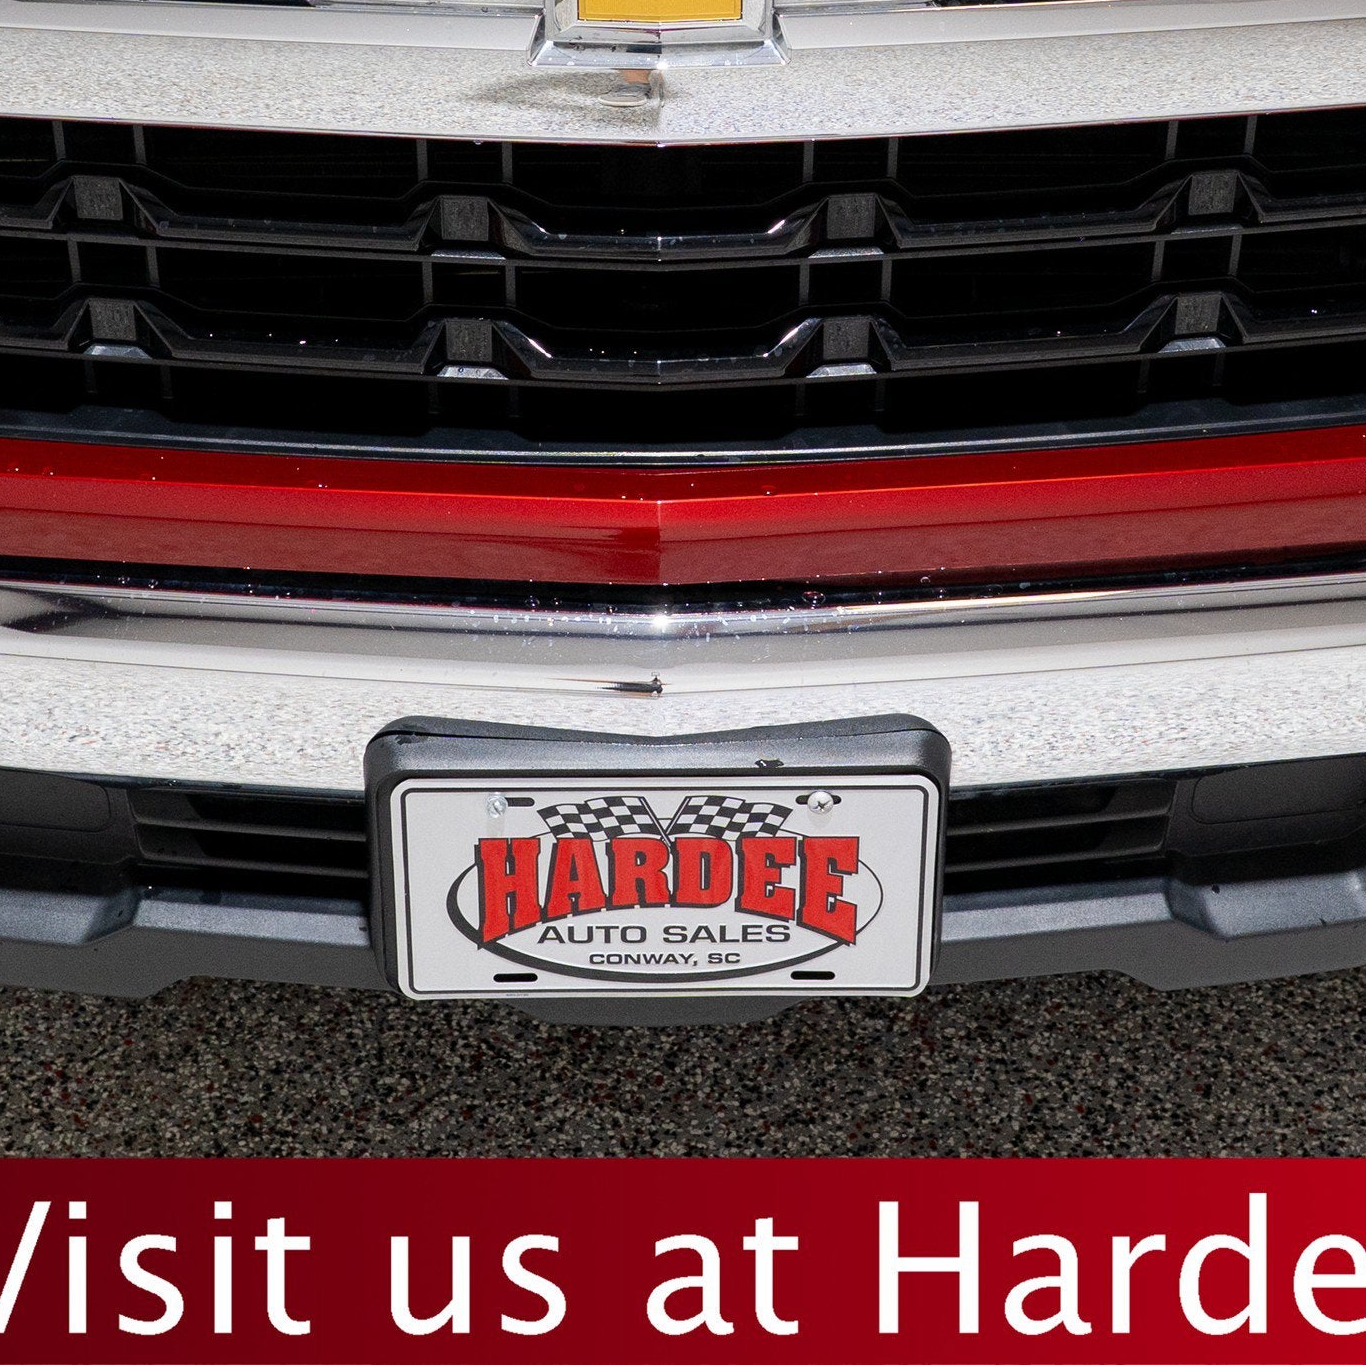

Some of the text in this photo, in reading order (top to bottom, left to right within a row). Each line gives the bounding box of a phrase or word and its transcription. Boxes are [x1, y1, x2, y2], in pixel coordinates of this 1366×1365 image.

[474, 836, 861, 949] HARDEE
[537, 924, 791, 945] AUTO SALES
[588, 952, 742, 968] CONWAY, SC
